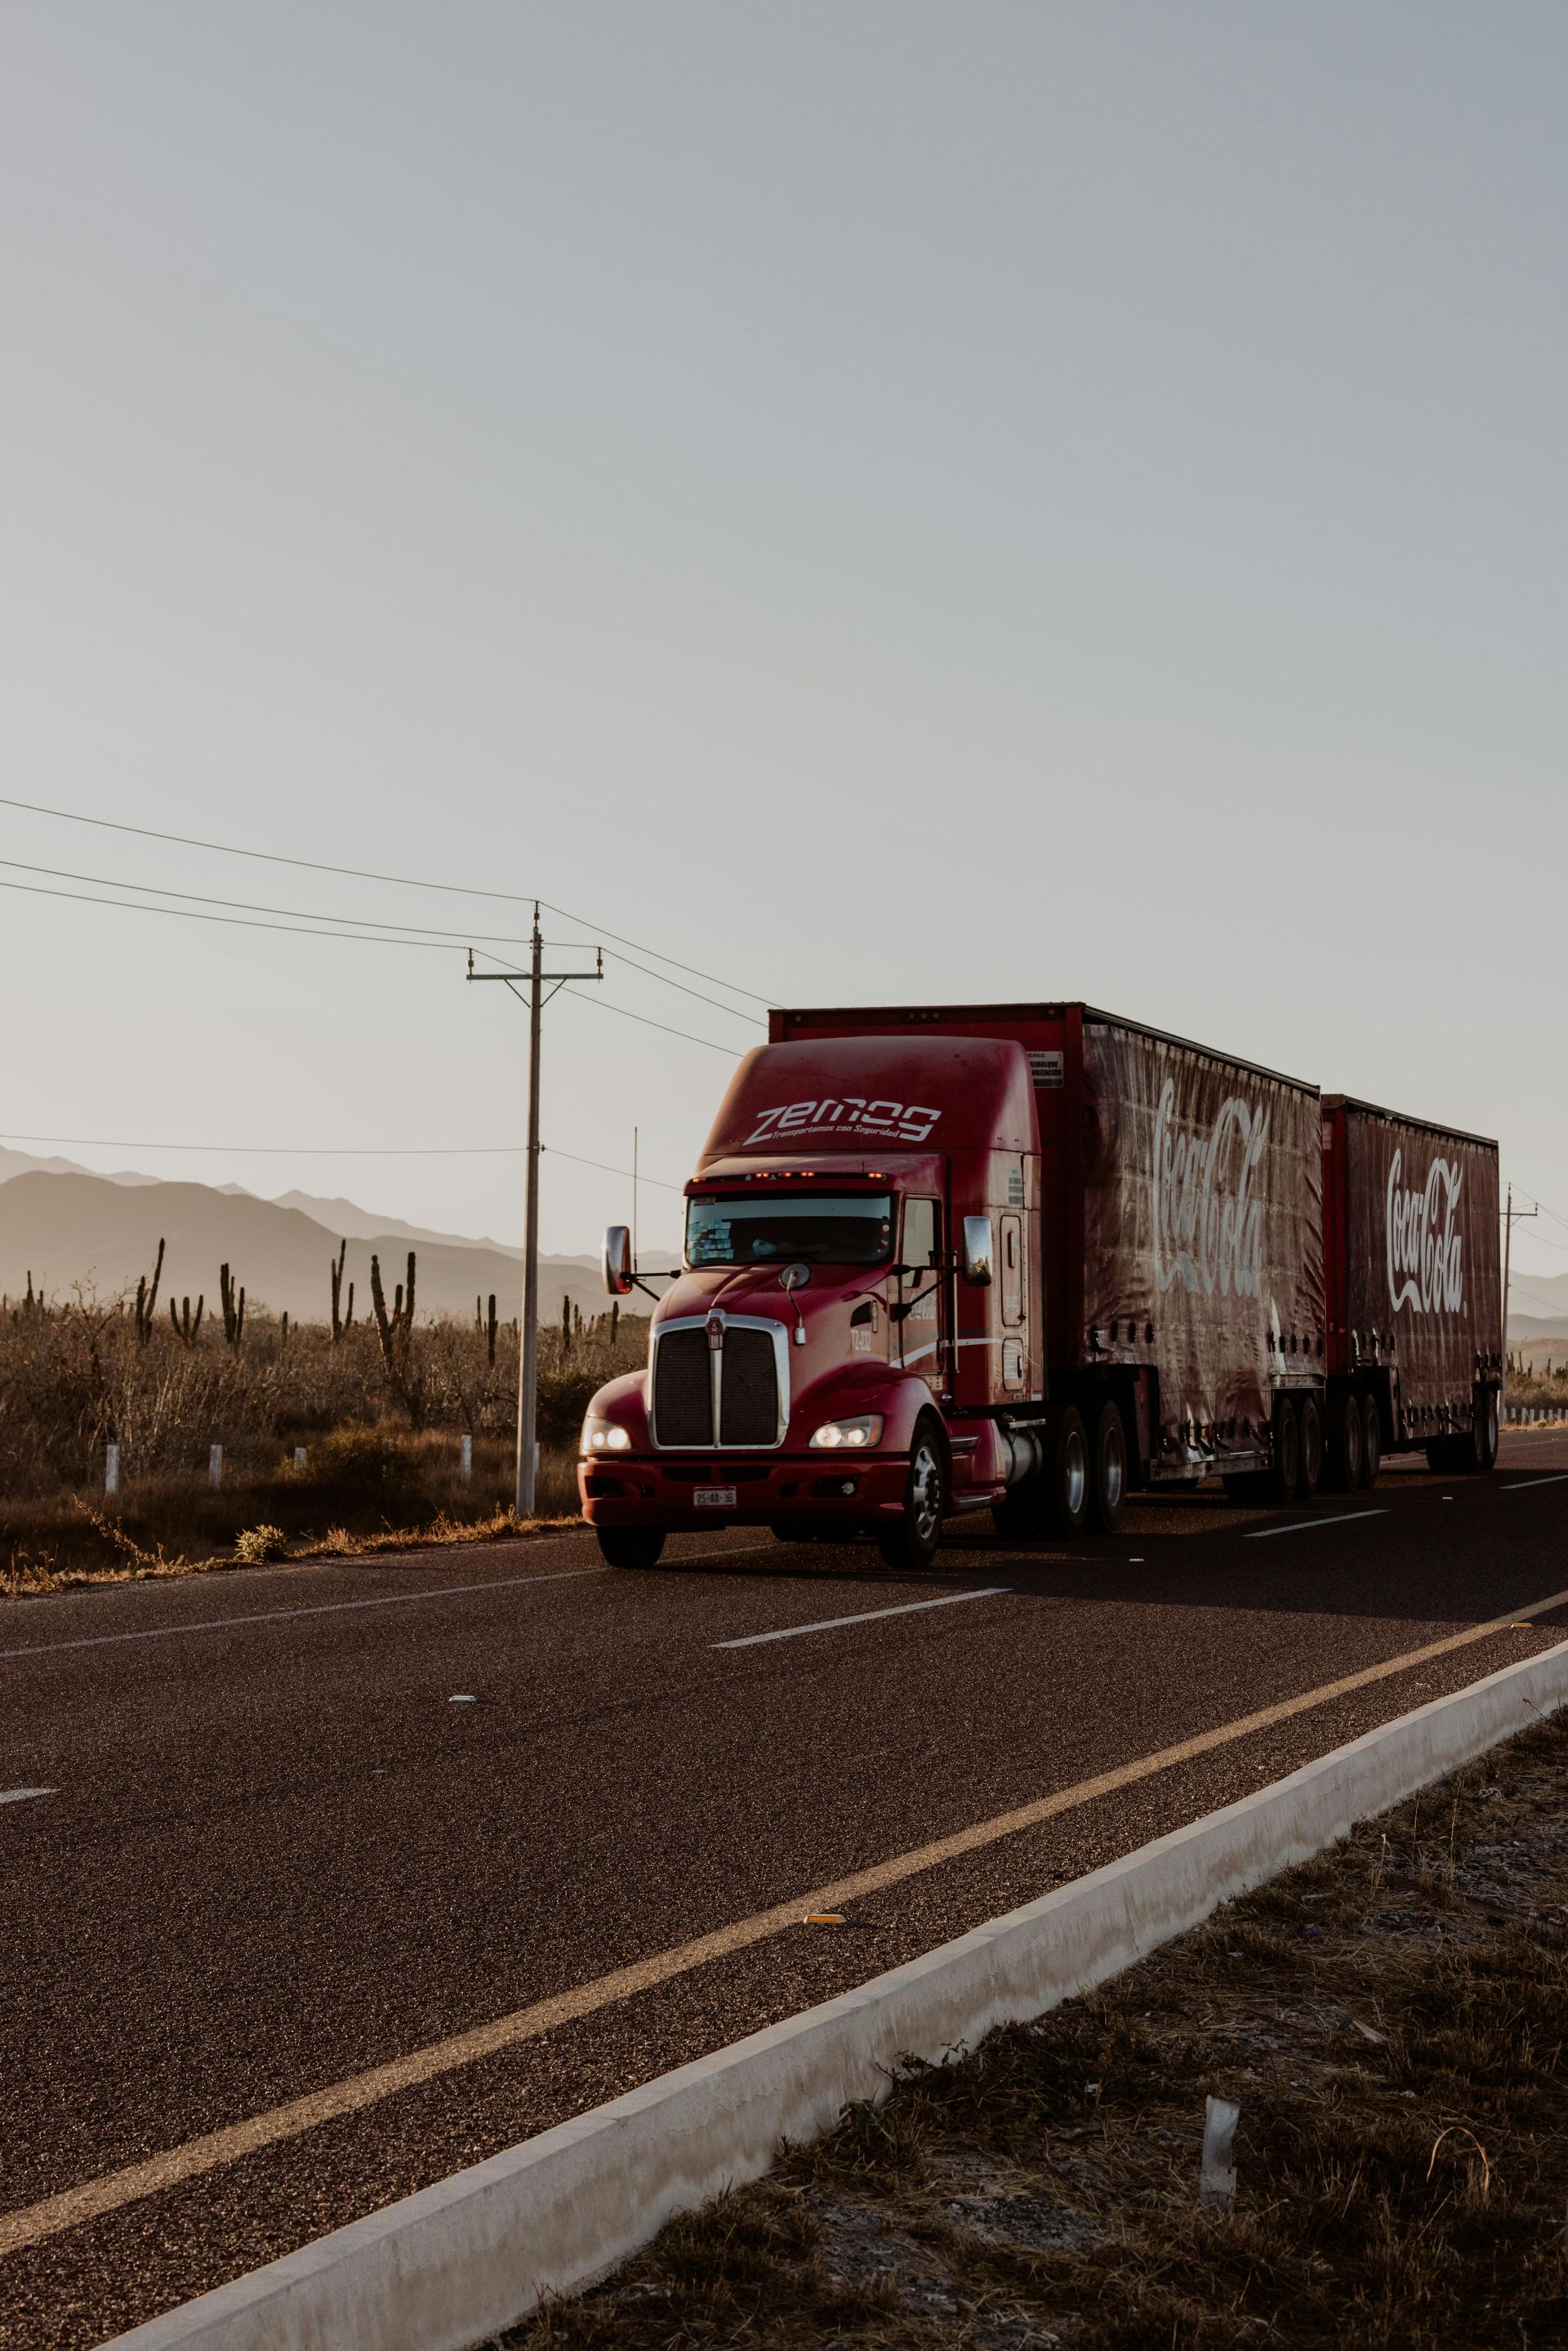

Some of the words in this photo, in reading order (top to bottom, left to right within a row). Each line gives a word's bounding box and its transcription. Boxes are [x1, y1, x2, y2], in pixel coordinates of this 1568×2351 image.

[772, 1125, 834, 1139] Transportamos
[853, 1124, 900, 1138] Seguridad
[1152, 1077, 1271, 1298] Coca-Cola
[1387, 1148, 1463, 1314] Coca-Cola
